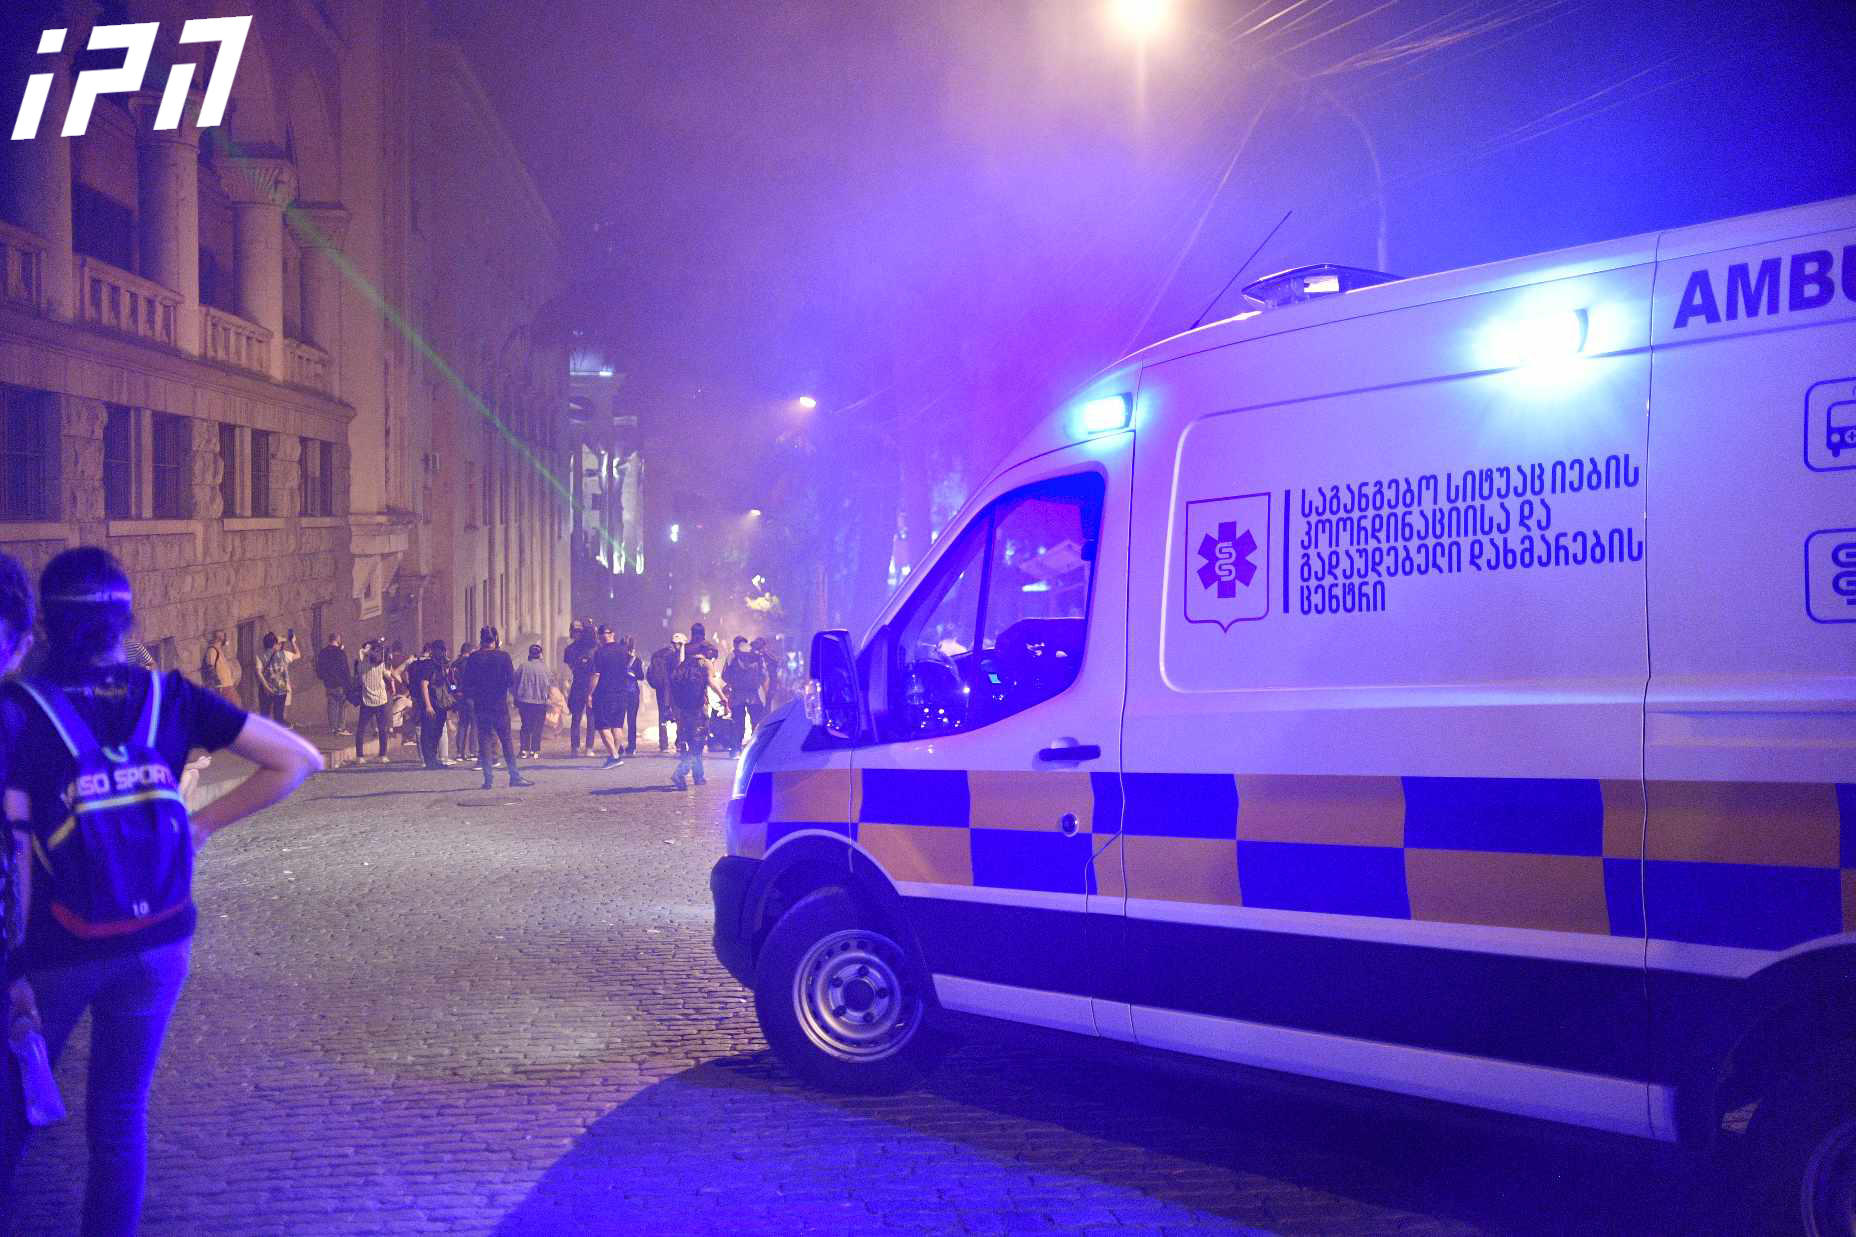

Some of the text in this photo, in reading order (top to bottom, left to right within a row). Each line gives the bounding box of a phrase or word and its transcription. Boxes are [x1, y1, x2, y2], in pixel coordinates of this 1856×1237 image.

[1300, 453, 1640, 518] საგანგებო სიტუაციების
[1300, 498, 1551, 551] კოორდინაციისა და
[1300, 527, 1643, 582] გადაუდებელი დახმარების
[1300, 580, 1386, 615] ცენტრი
